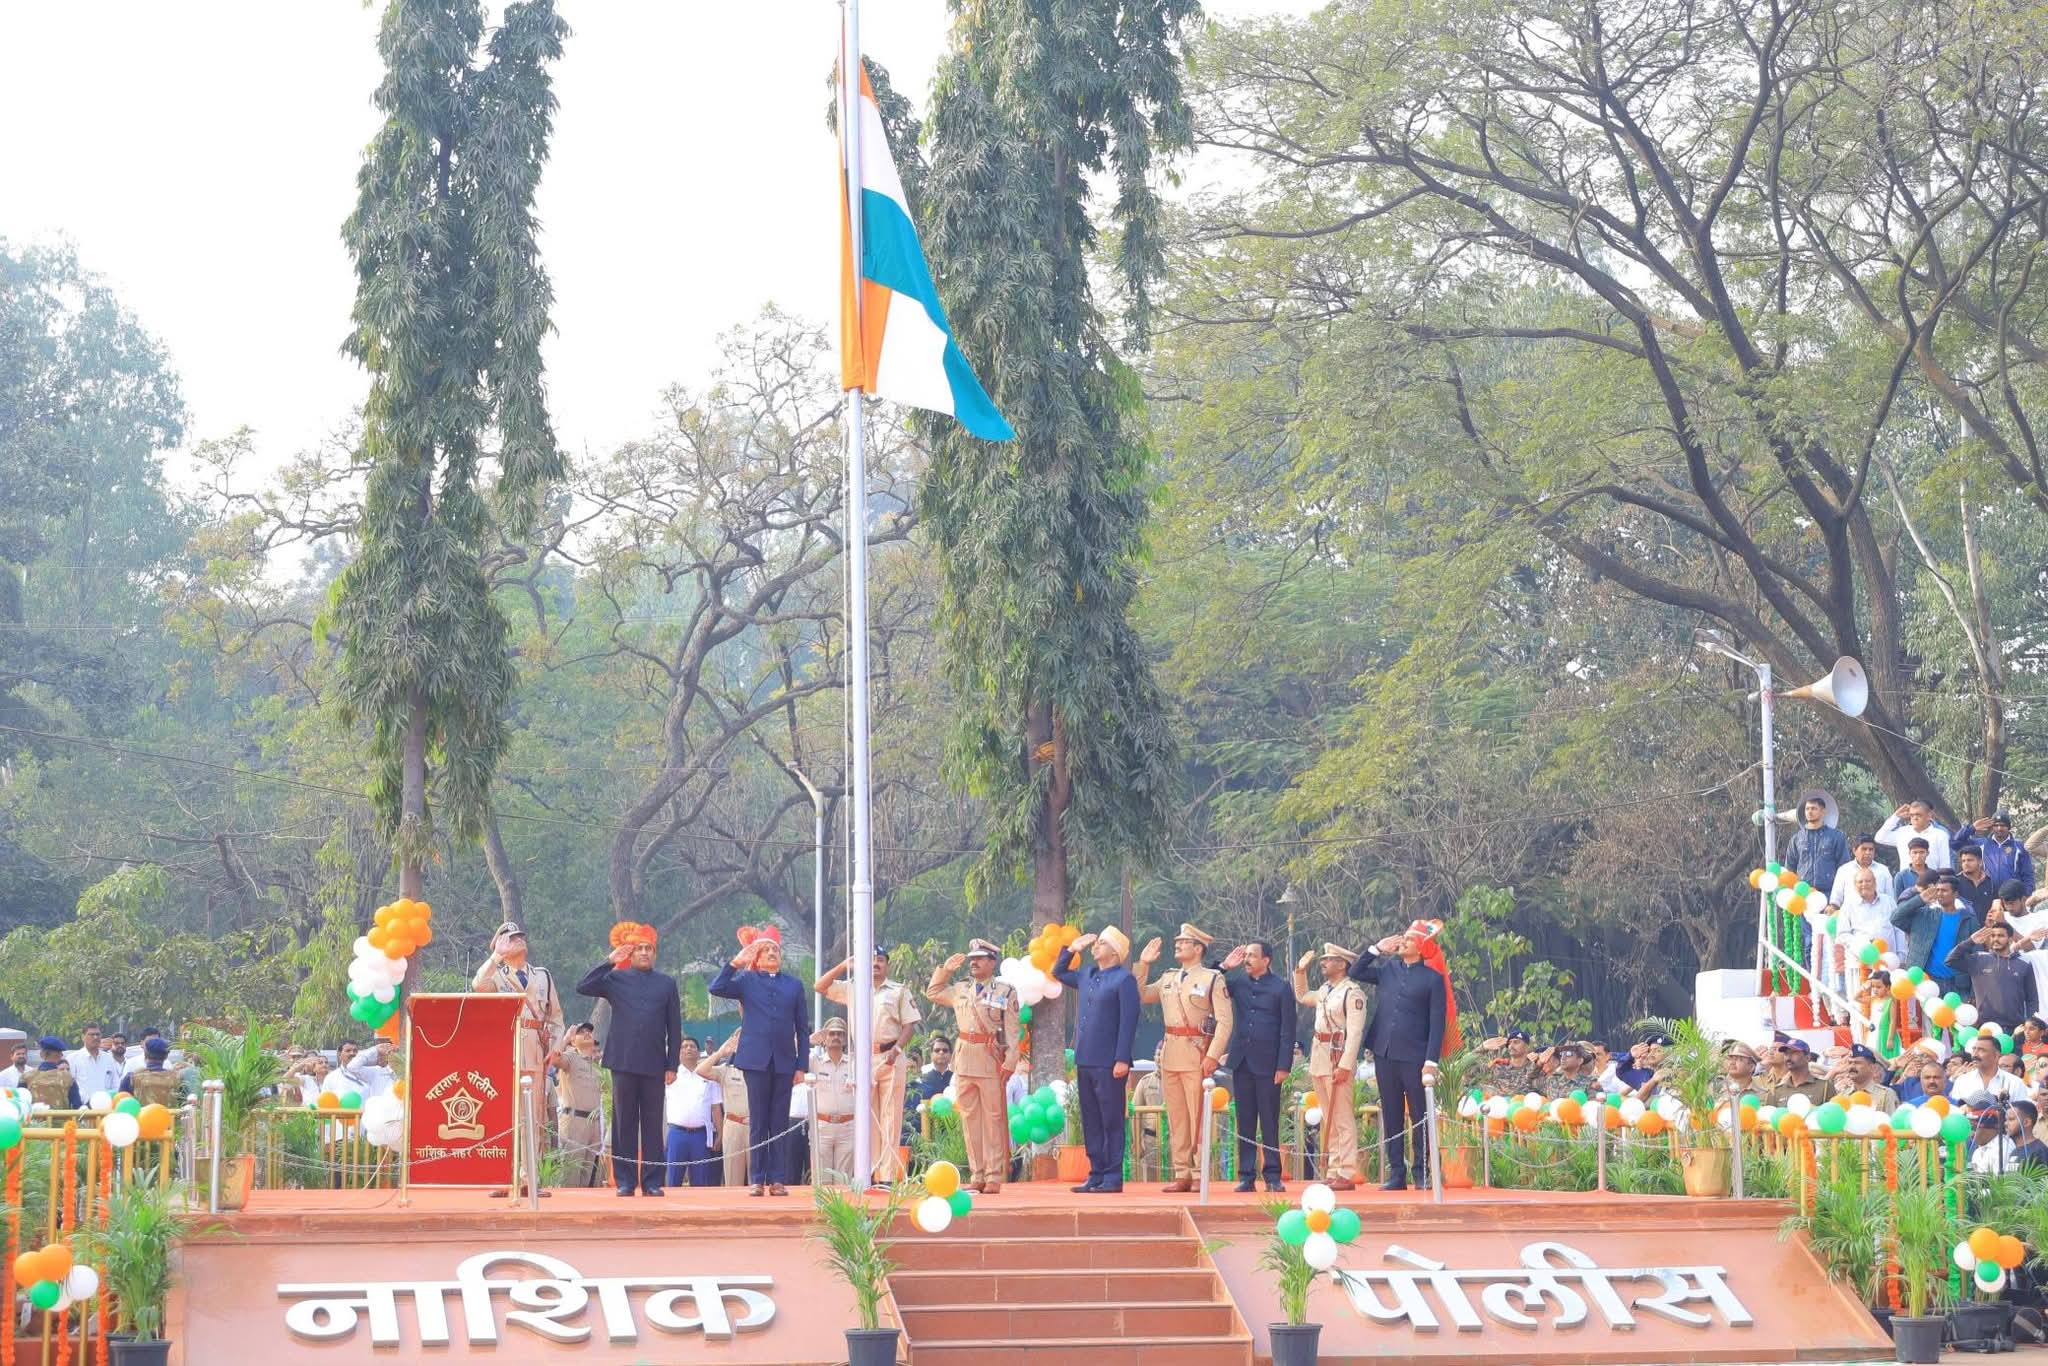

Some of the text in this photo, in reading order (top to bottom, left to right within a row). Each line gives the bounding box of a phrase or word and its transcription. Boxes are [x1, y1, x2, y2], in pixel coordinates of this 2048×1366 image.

[425, 1070, 499, 1101] महाराष्ट्र पोलीस
[415, 1145, 448, 1160] नाशिक
[476, 1144, 507, 1159] पोलीस
[277, 1251, 776, 1347] नाशिक
[1333, 1241, 1754, 1333] पोलीस
